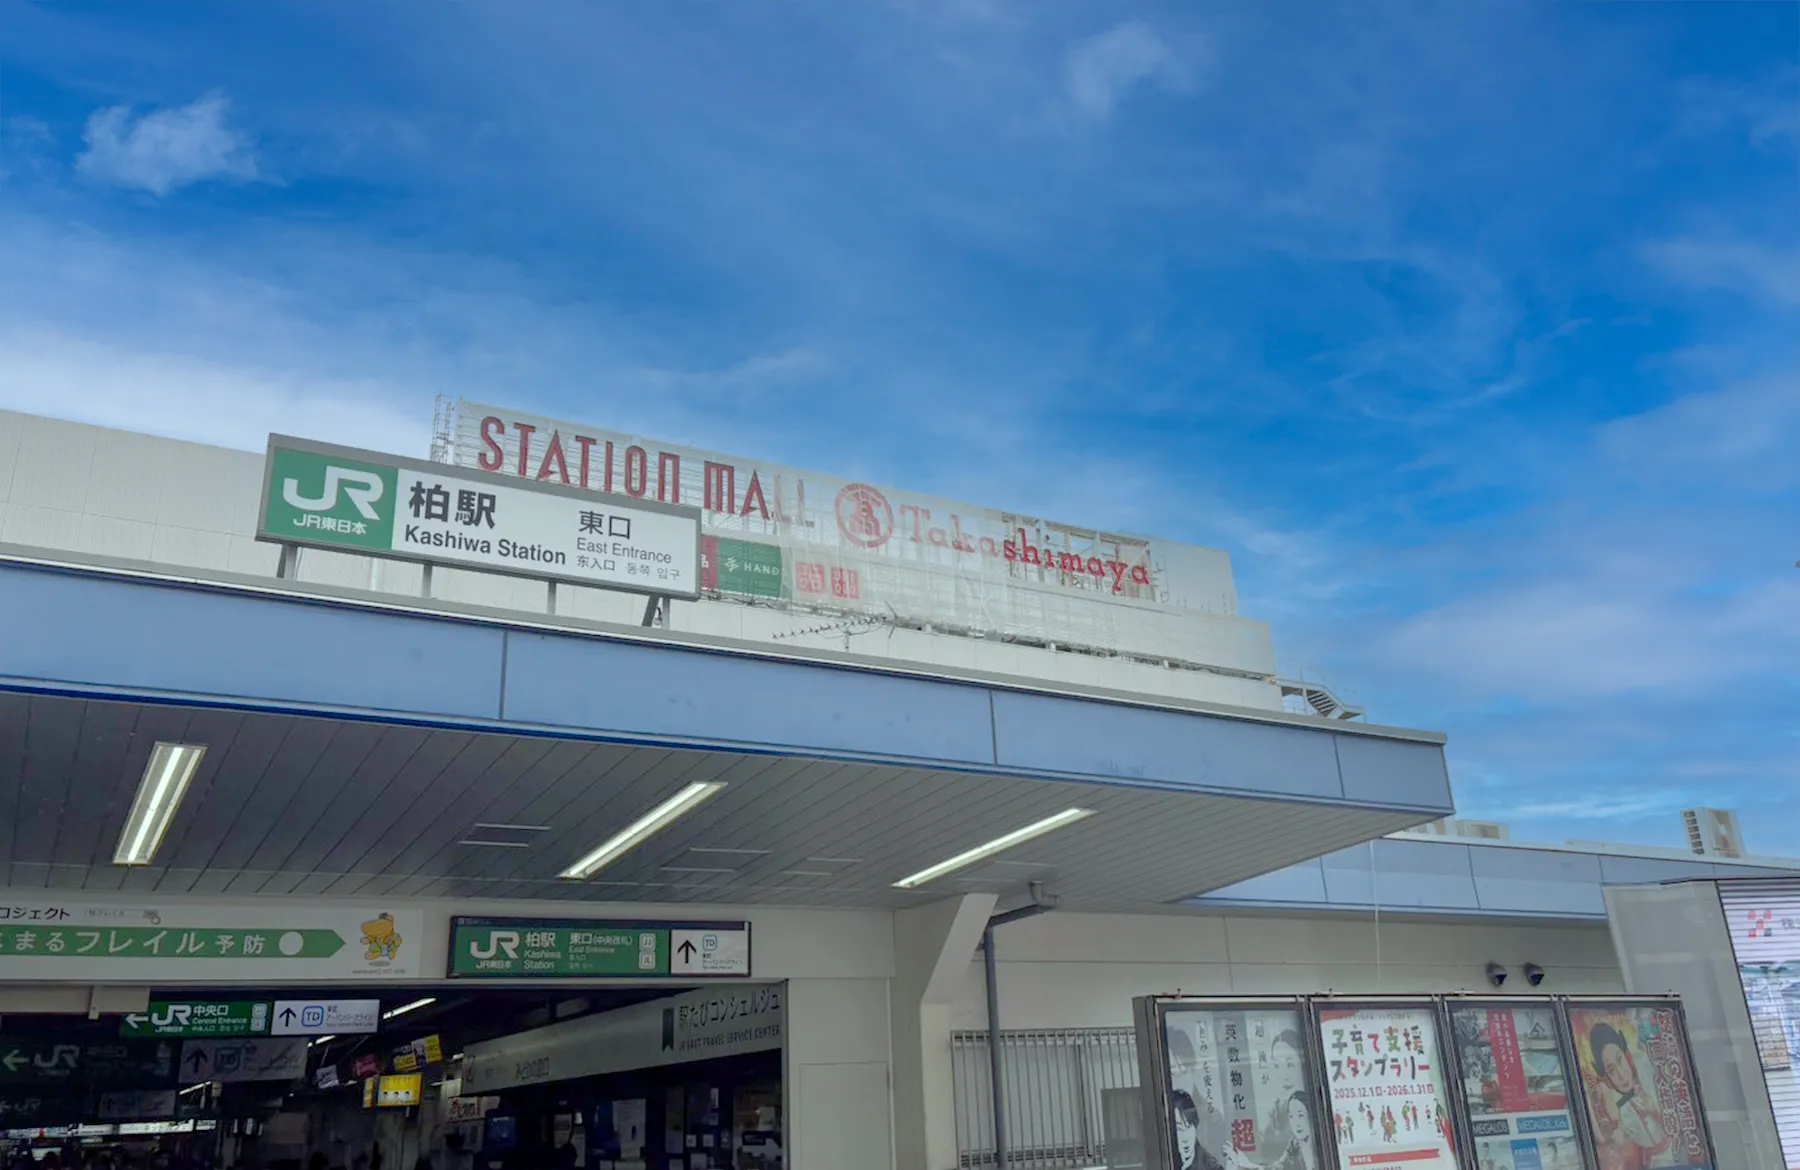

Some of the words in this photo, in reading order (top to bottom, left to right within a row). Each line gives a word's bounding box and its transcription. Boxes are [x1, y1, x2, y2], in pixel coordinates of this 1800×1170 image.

[283, 465, 384, 521] JR
[409, 480, 497, 530] 柏駅
[293, 513, 368, 535] JR東日本
[578, 510, 632, 540] 東口
[405, 524, 491, 554] Kashiwa
[498, 539, 566, 565] Station
[577, 537, 609, 555] East
[612, 542, 673, 565] Entrance
[900, 505, 1150, 592] Takashimaya
[577, 555, 616, 573] 东入口
[627, 562, 651, 576] 동쪽
[657, 567, 681, 580] 입구
[0, 929, 267, 956] まるフレイル予防
[470, 931, 521, 959] JR
[525, 931, 556, 948] 柏駅
[524, 949, 561, 960] Kashiwa
[524, 960, 555, 970] Station
[151, 1005, 192, 1026] JR
[192, 1017, 217, 1025] Central
[218, 1017, 247, 1025] Entrance
[193, 1004, 229, 1017] 中央口
[305, 1012, 320, 1022] TD
[679, 988, 780, 1033] 駅たびコンシェルジュ
[754, 1024, 780, 1039] CENTER
[1331, 1024, 1424, 1055] 子育て支援
[1330, 1053, 1431, 1082] スタンプラリー
